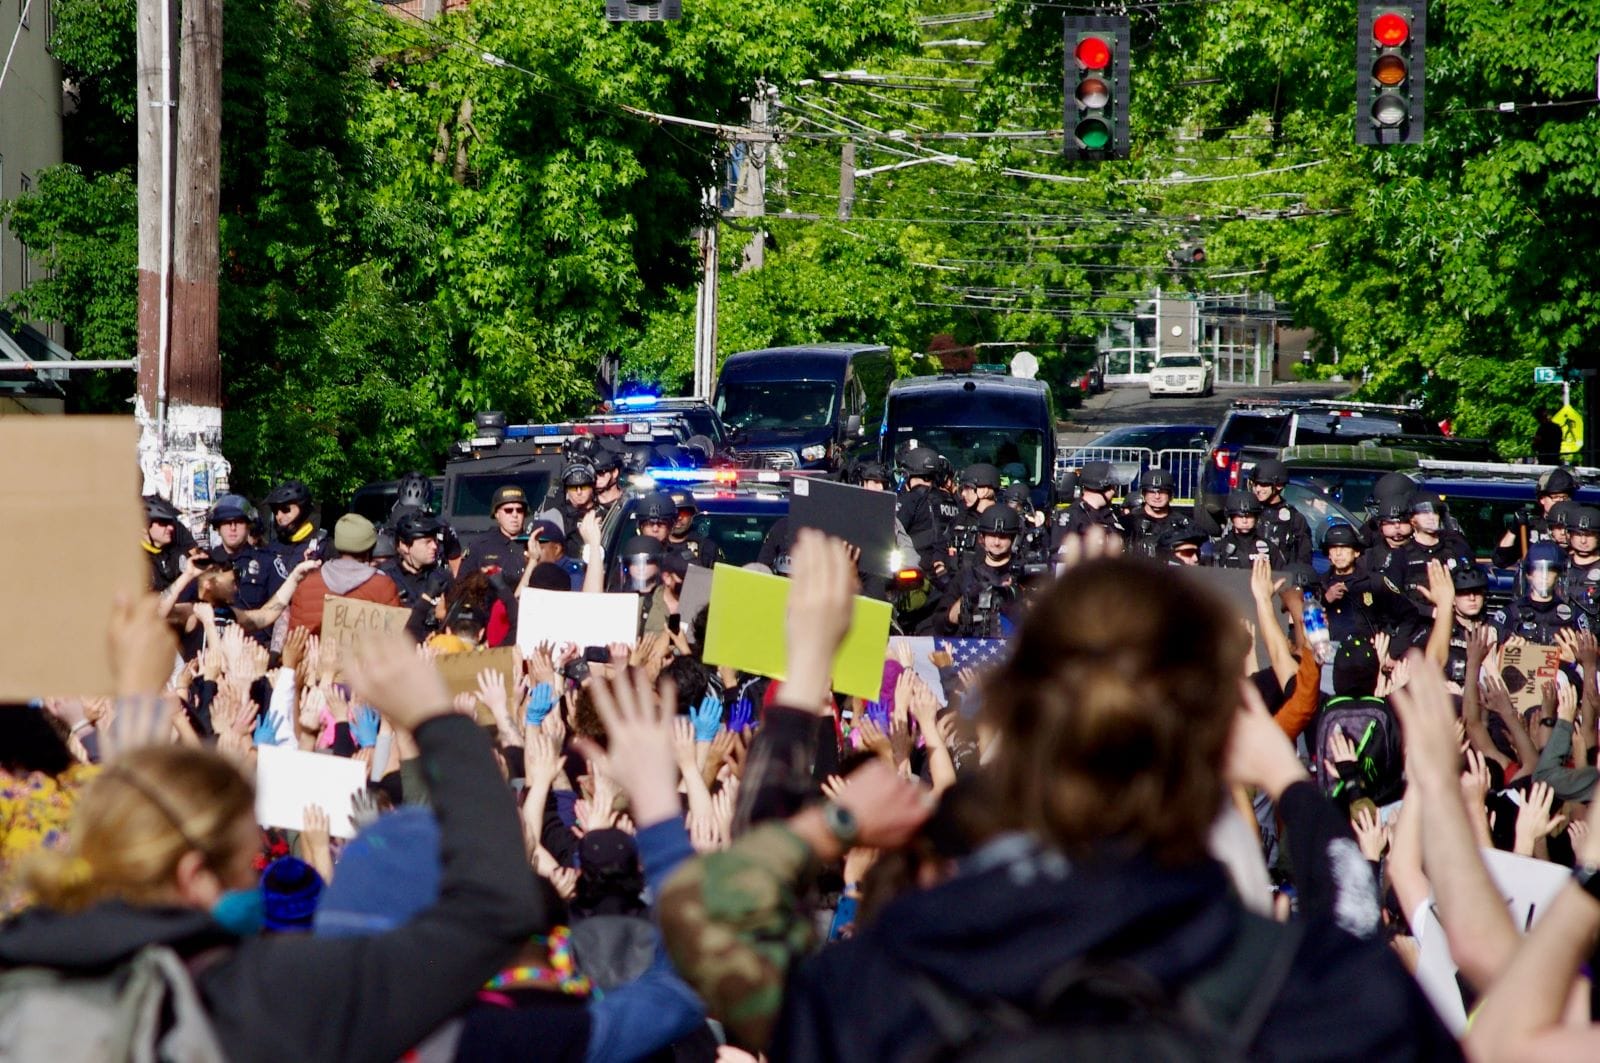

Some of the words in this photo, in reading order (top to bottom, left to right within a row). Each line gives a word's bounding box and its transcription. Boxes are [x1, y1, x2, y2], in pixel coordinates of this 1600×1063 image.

[940, 504, 959, 516] POLIC
[334, 604, 394, 636] BLACK
[1503, 647, 1522, 665] HIS
[1536, 650, 1559, 677] Floyd
[1526, 669, 1536, 695] NAME
